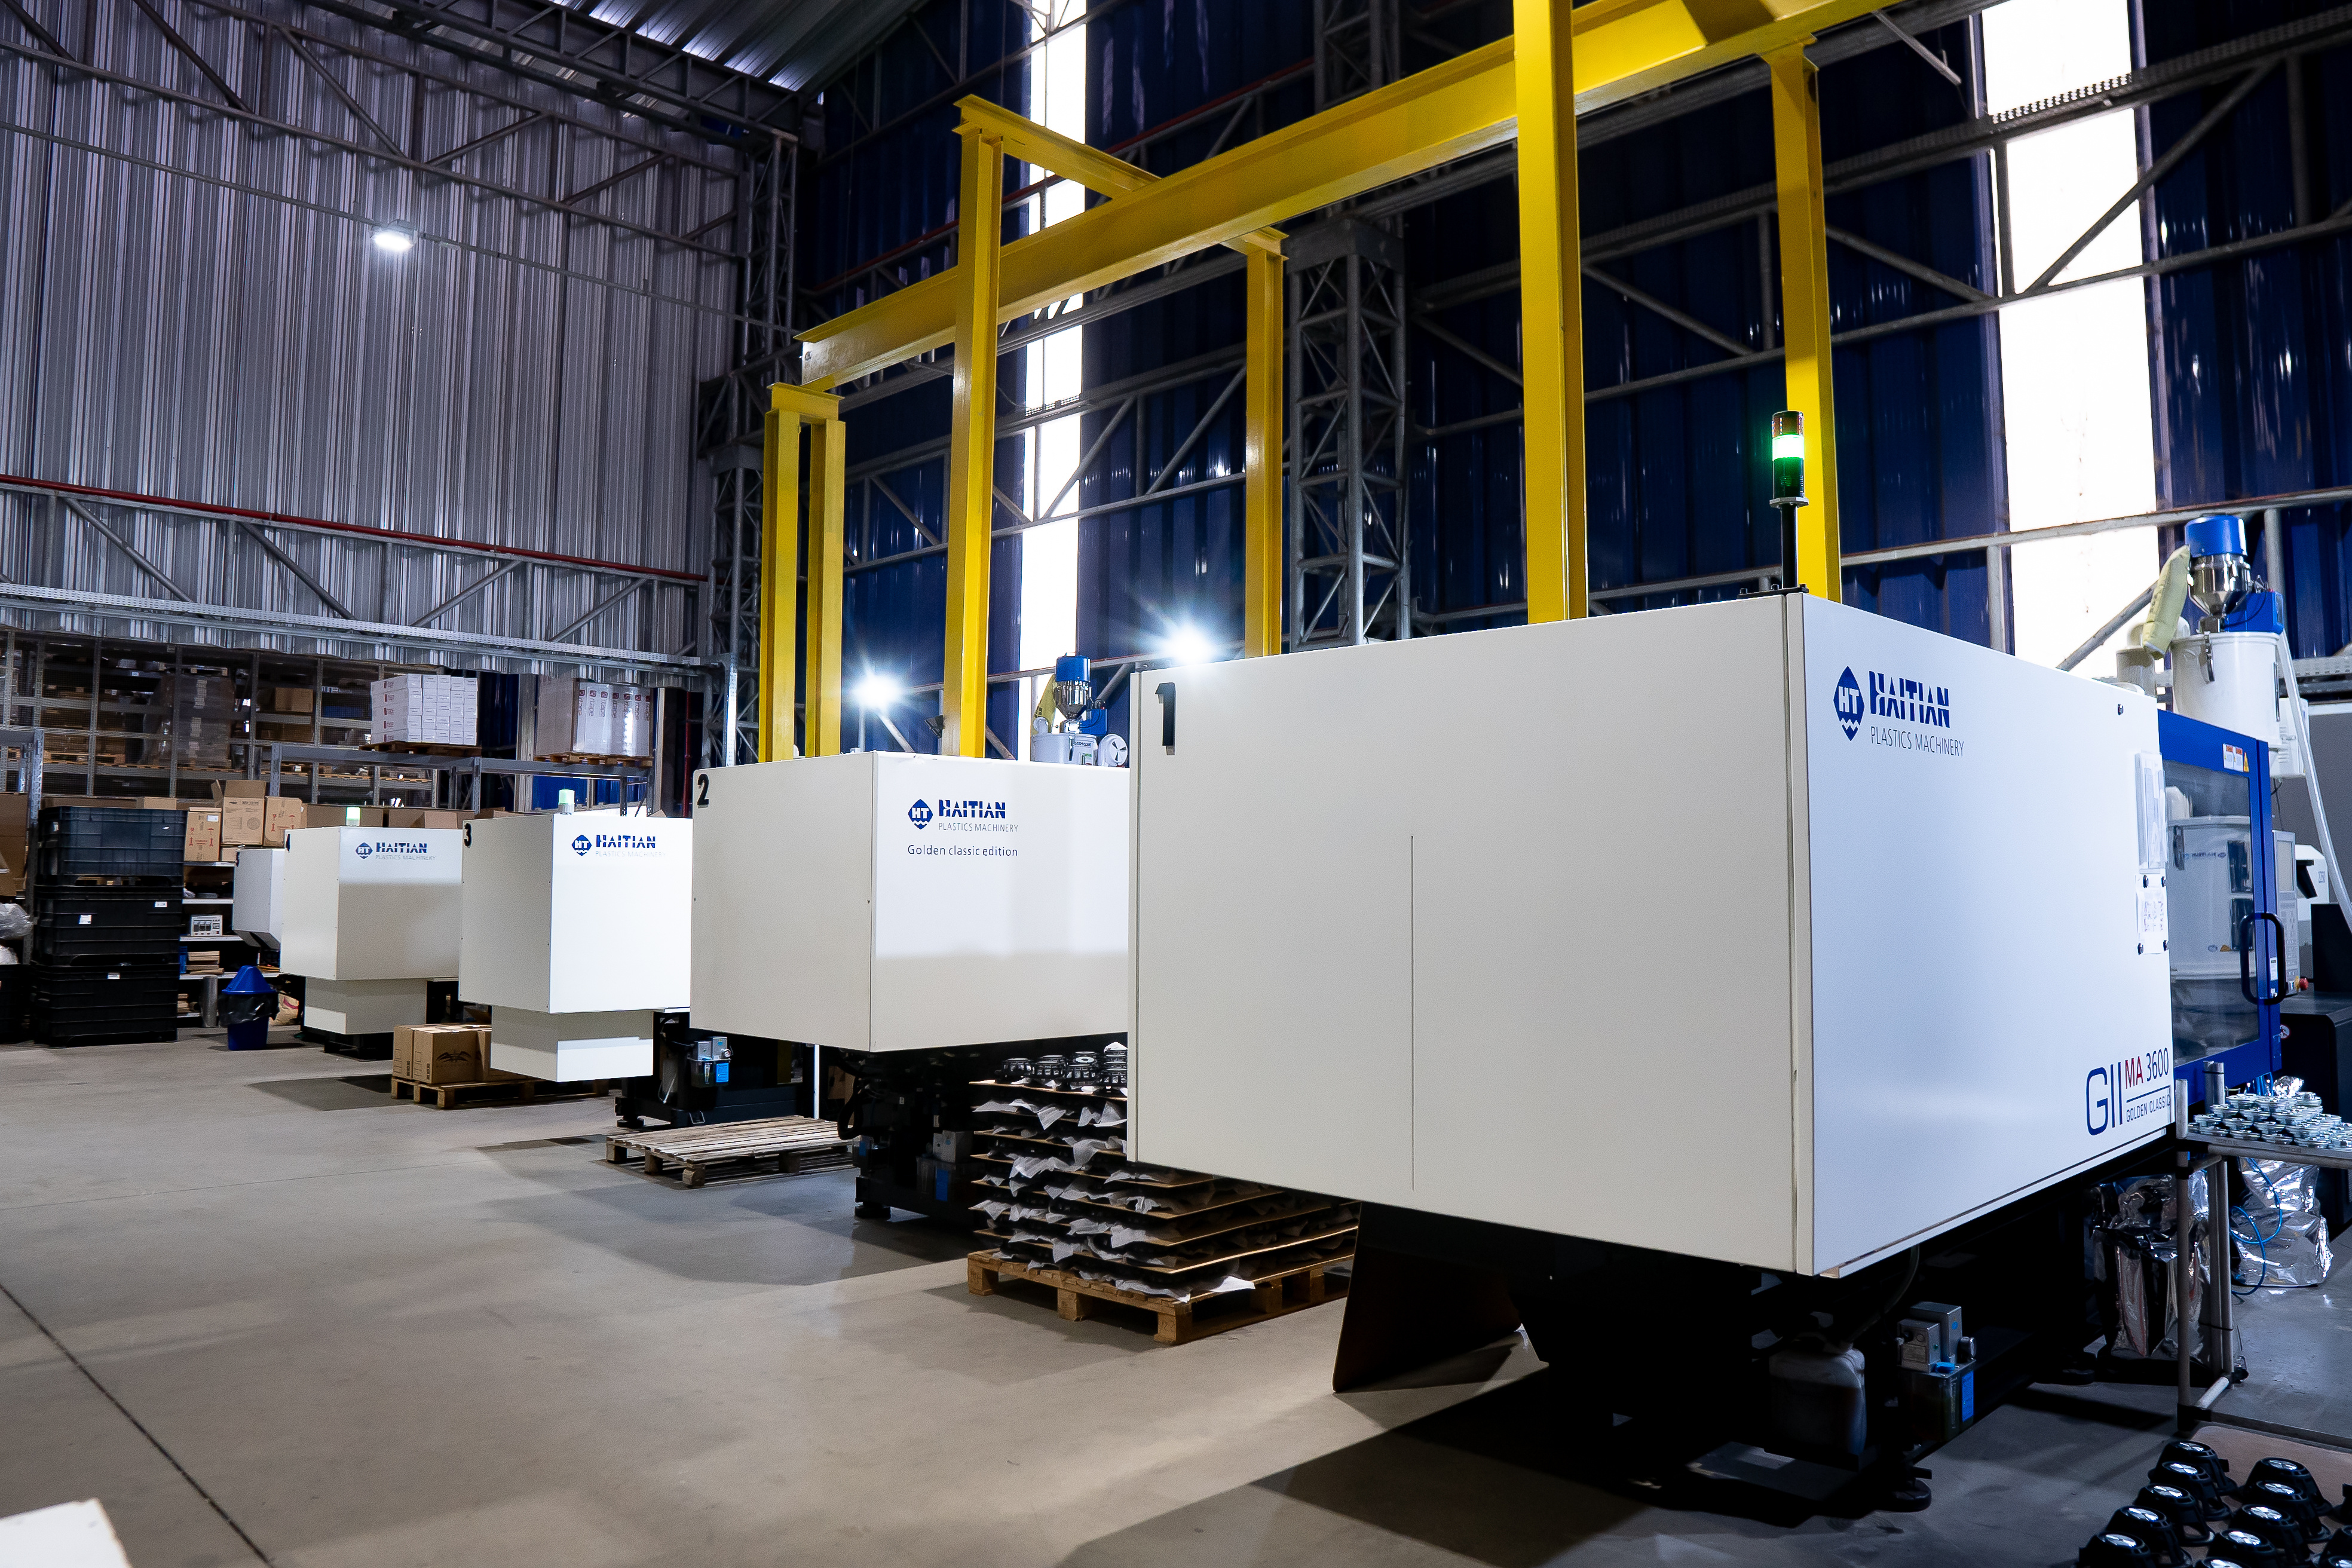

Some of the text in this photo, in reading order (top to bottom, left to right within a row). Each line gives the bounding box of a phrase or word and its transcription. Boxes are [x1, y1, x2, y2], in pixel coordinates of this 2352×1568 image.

[1869, 670, 1950, 728] HAITIAN
[1155, 682, 1176, 747] 1
[1870, 726, 1964, 757] PLASTICS MACHINERY
[697, 773, 709, 807] 2
[938, 799, 1006, 819] HAITIAN
[464, 822, 472, 847] 3
[939, 822, 1018, 832] PLASTICS MACHINERY
[376, 842, 427, 853] HAITIAN
[596, 834, 656, 849] HAITIAN
[908, 844, 1018, 856] Golden classic edition
[2125, 1047, 2169, 1089] MA 3600
[2126, 1094, 2170, 1123] GOLDEN CLASSIC
